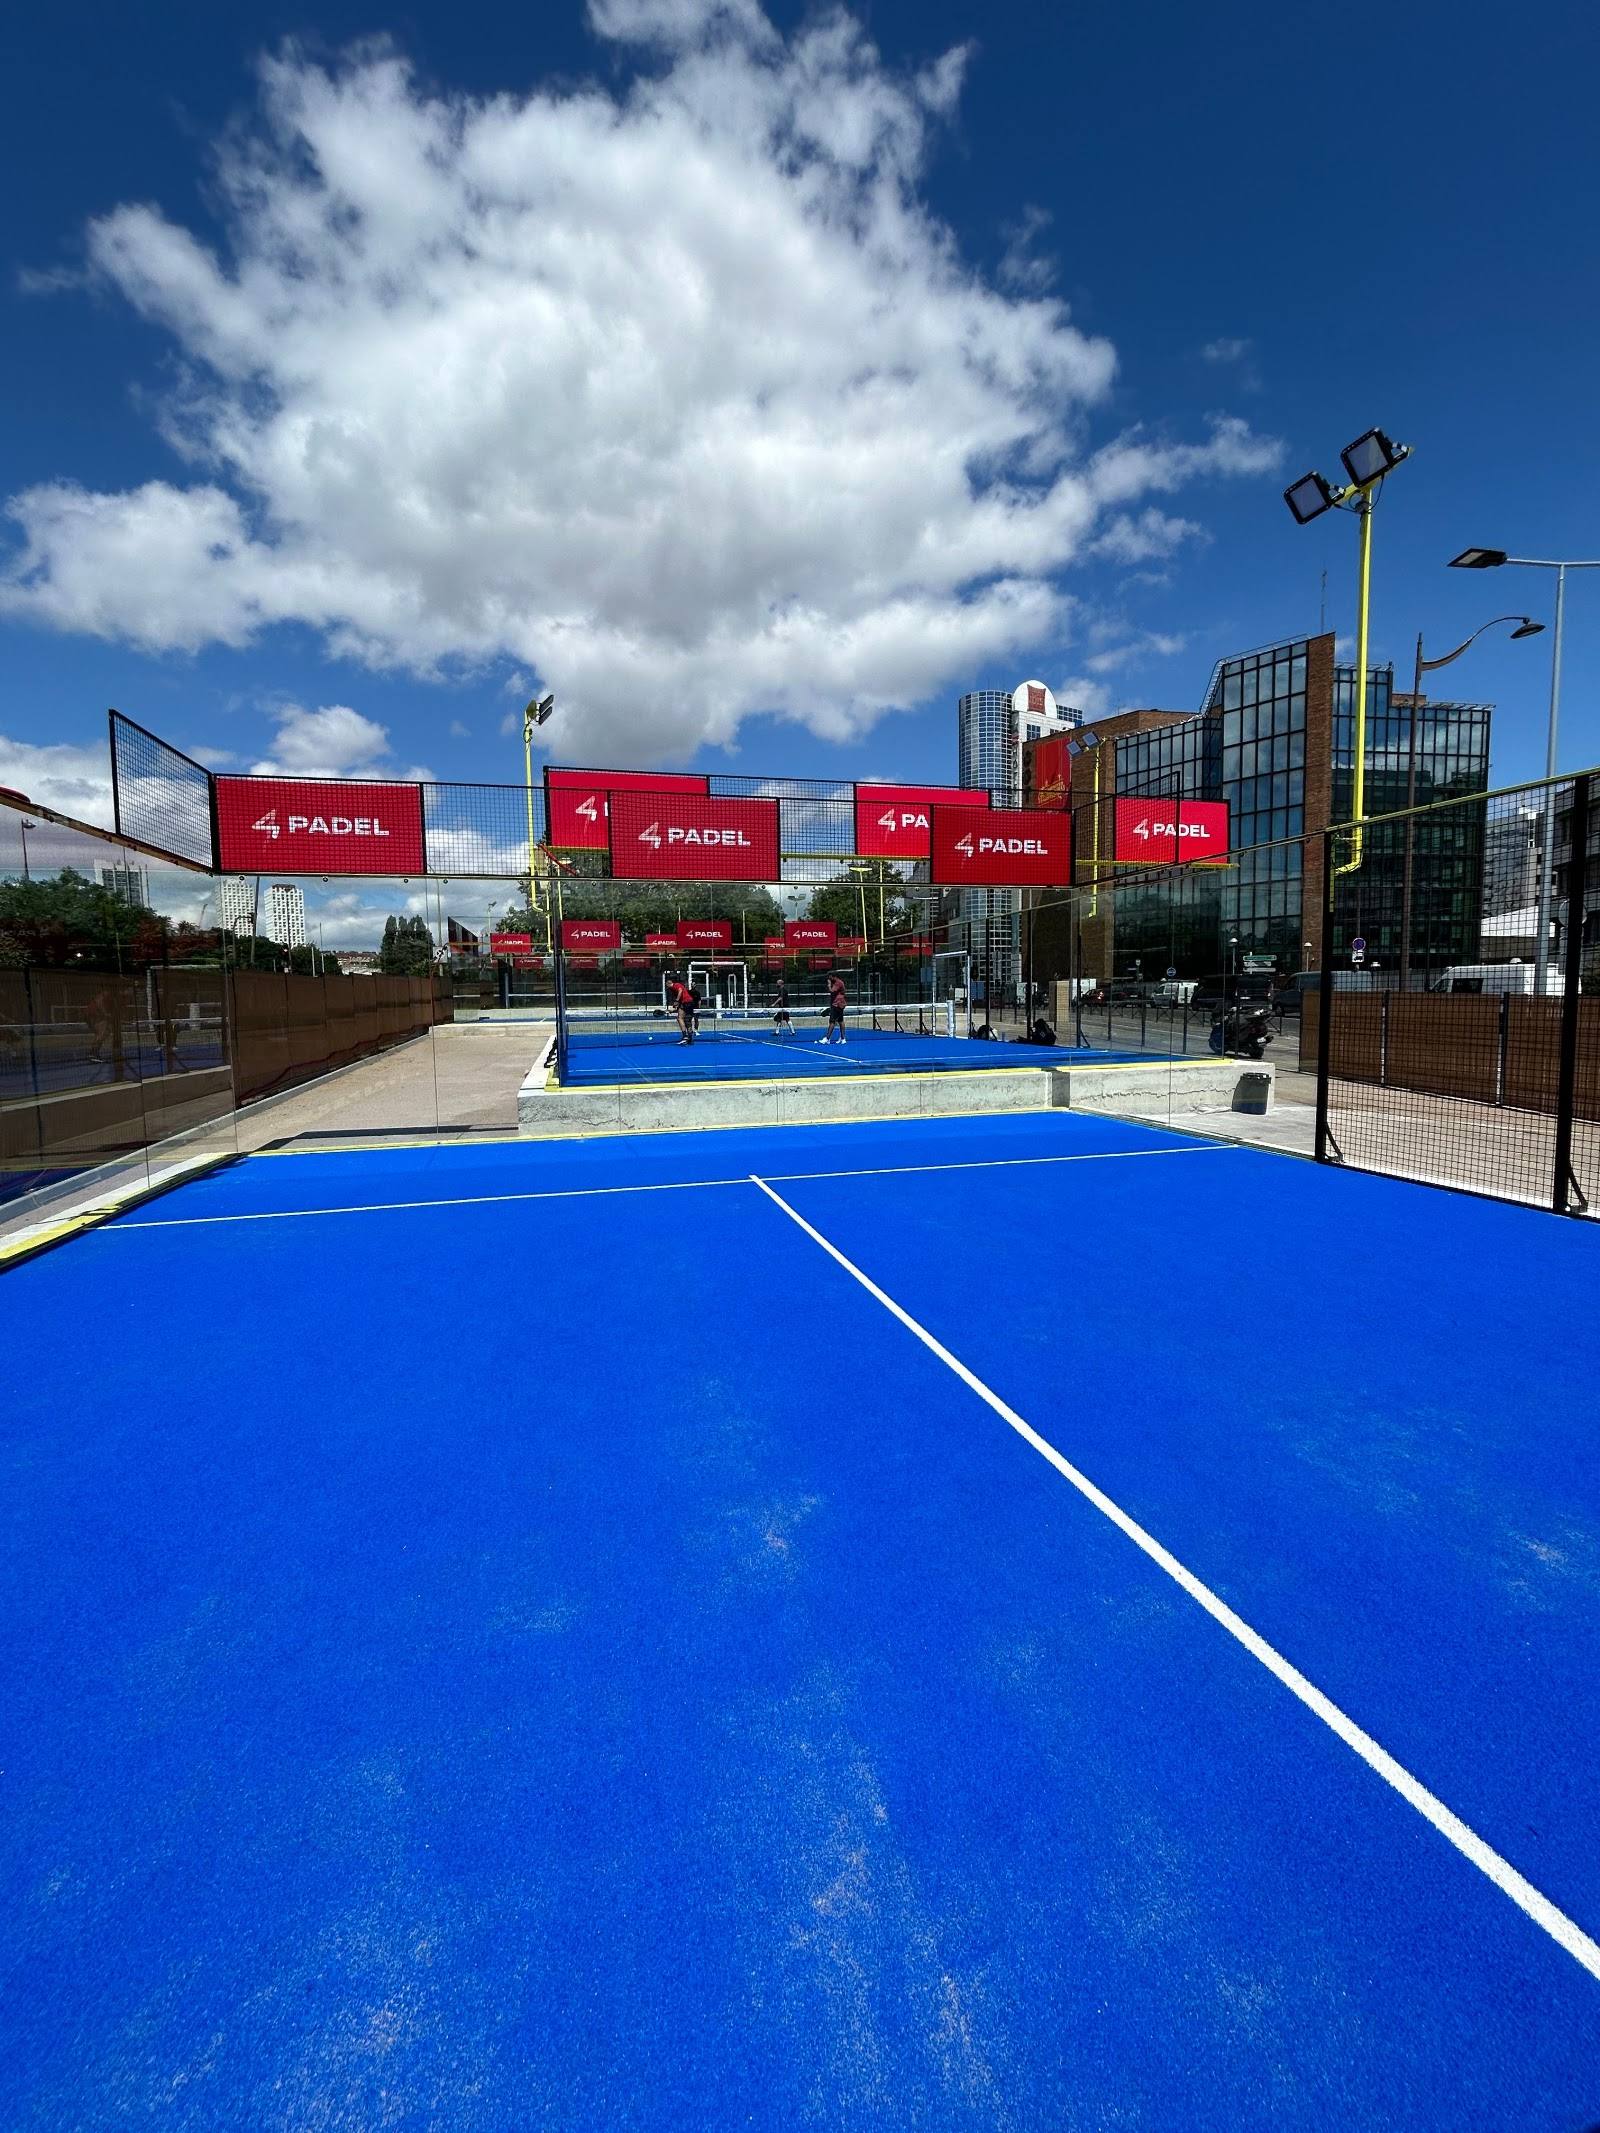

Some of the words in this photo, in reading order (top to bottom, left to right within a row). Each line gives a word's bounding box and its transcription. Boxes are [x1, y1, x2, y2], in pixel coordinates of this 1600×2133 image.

[288, 815, 390, 836] PADEL
[1153, 823, 1211, 838] PADEL
[668, 827, 751, 846] PADEL
[979, 838, 1048, 854] PADEL
